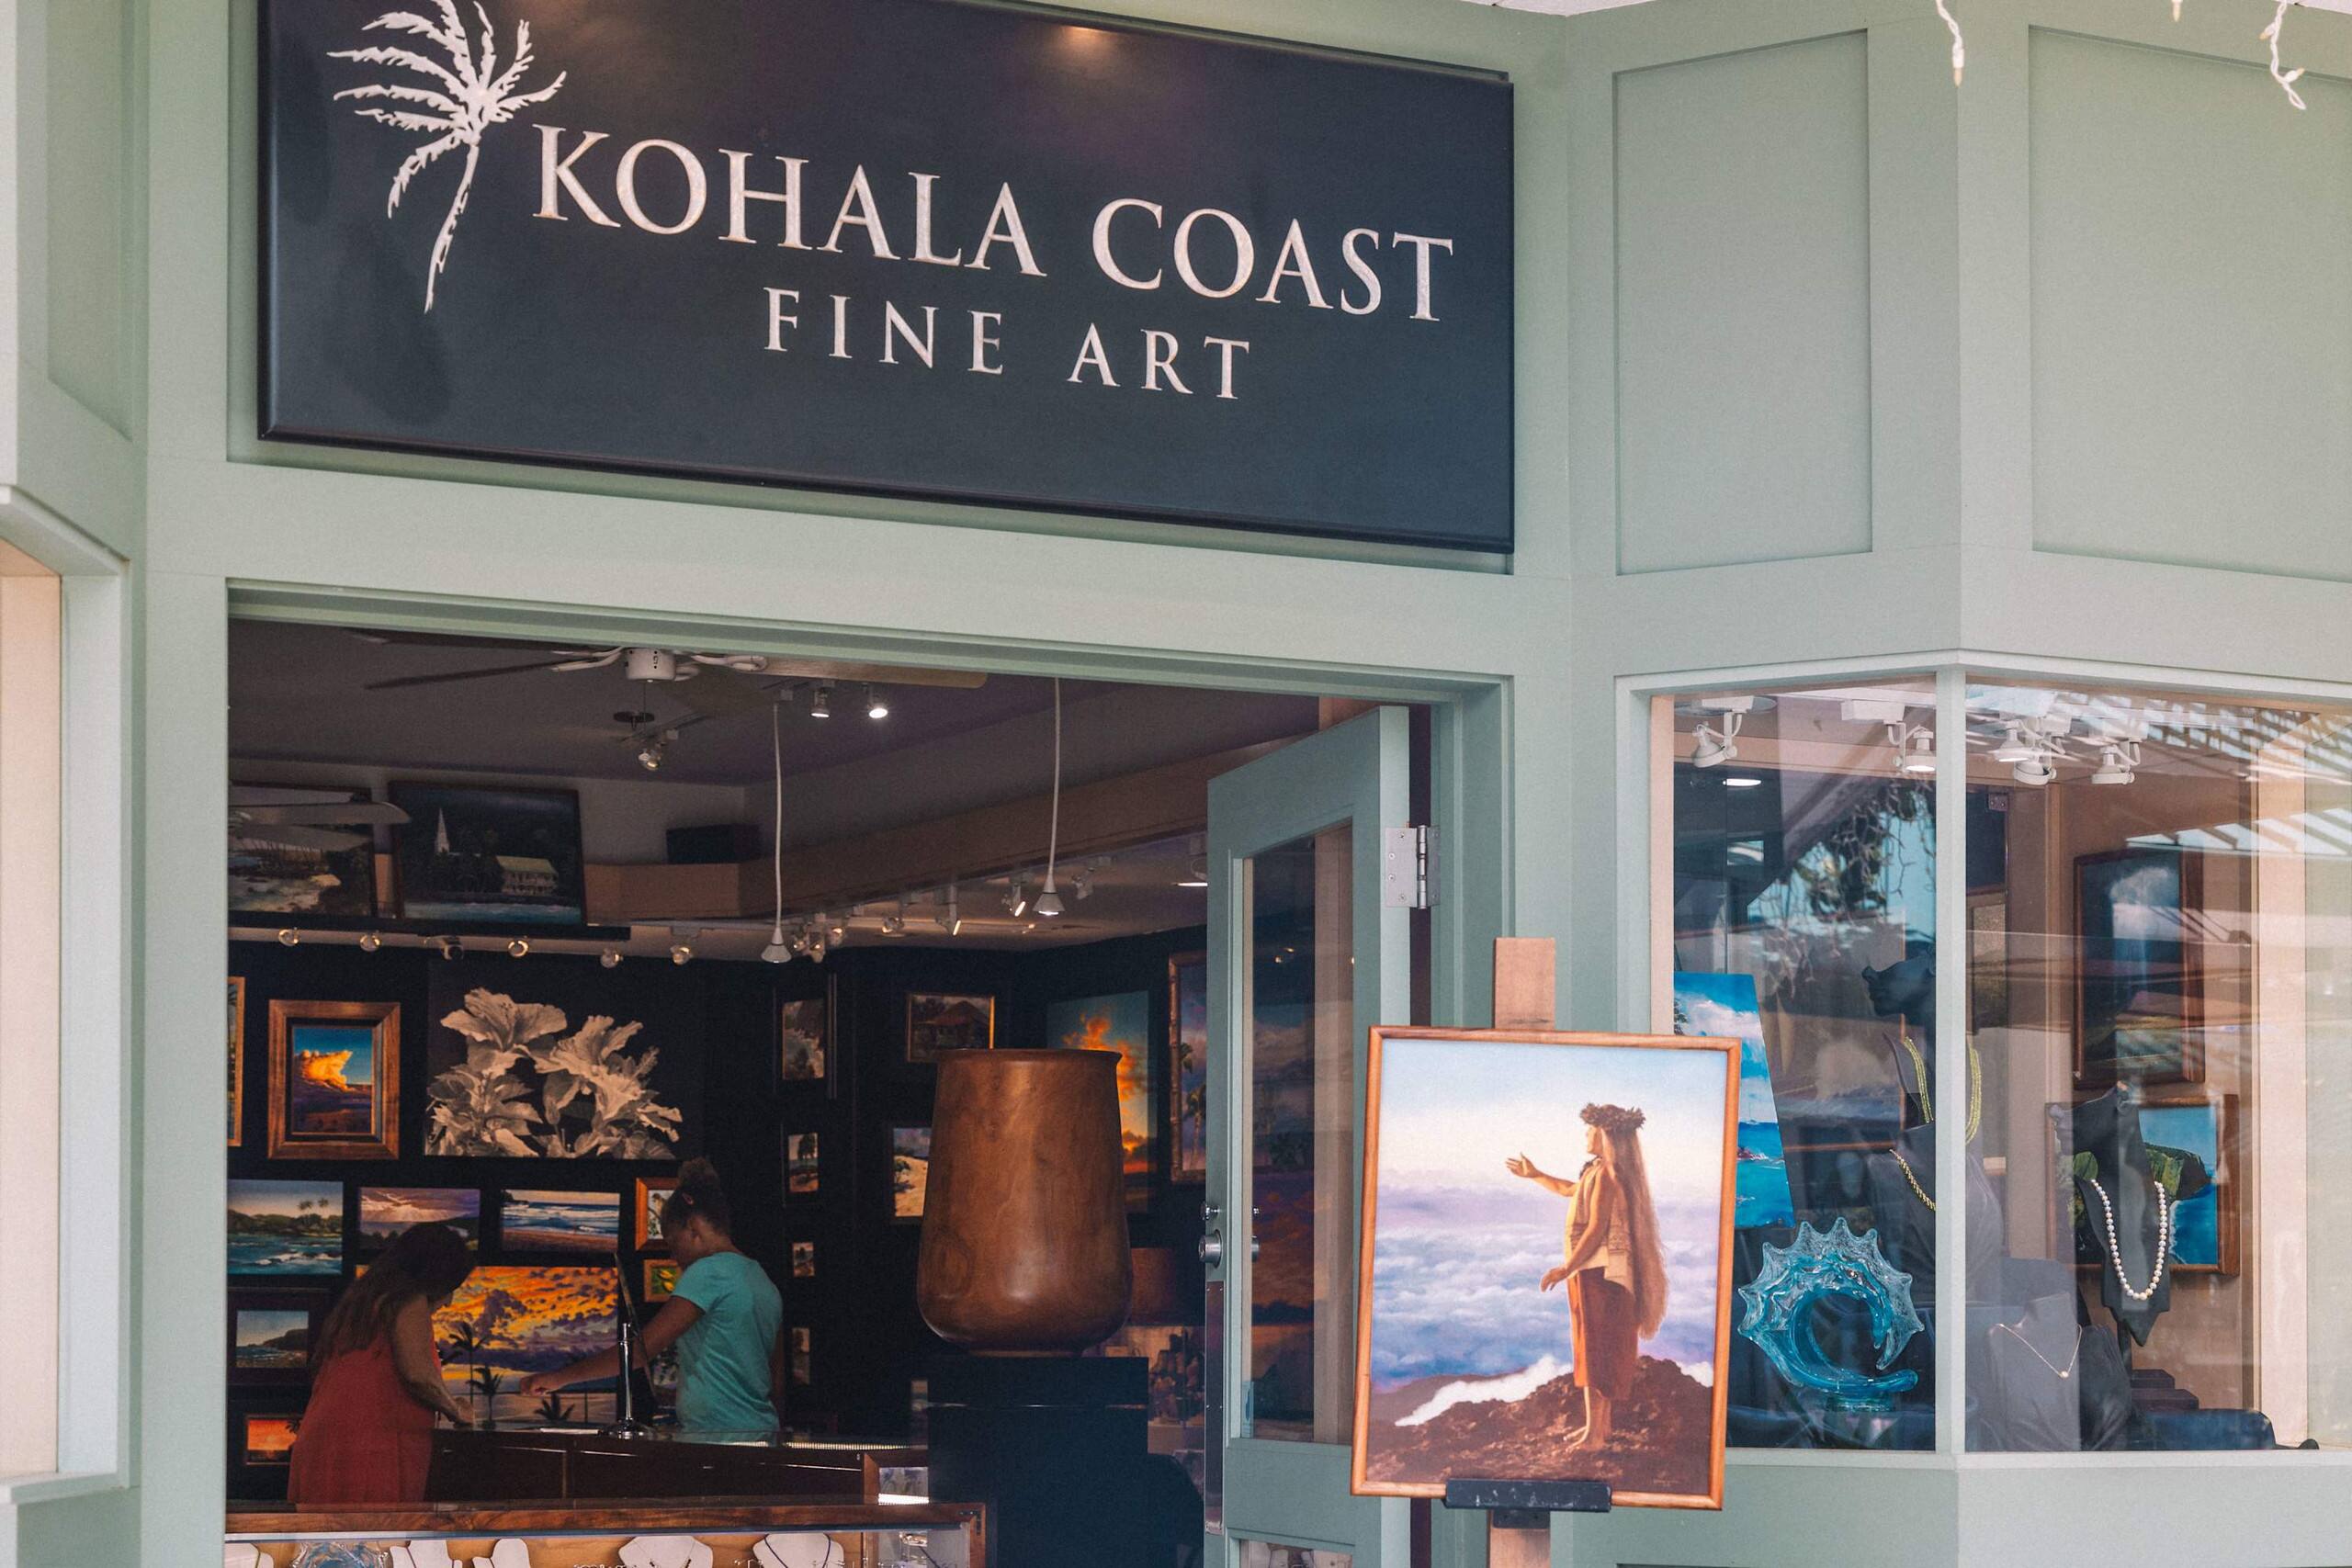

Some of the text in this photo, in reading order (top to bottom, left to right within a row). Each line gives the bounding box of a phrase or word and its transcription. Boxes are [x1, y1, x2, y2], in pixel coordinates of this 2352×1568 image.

[532, 123, 1454, 322] KOHALA COAST
[763, 286, 1250, 400] FINE ART
